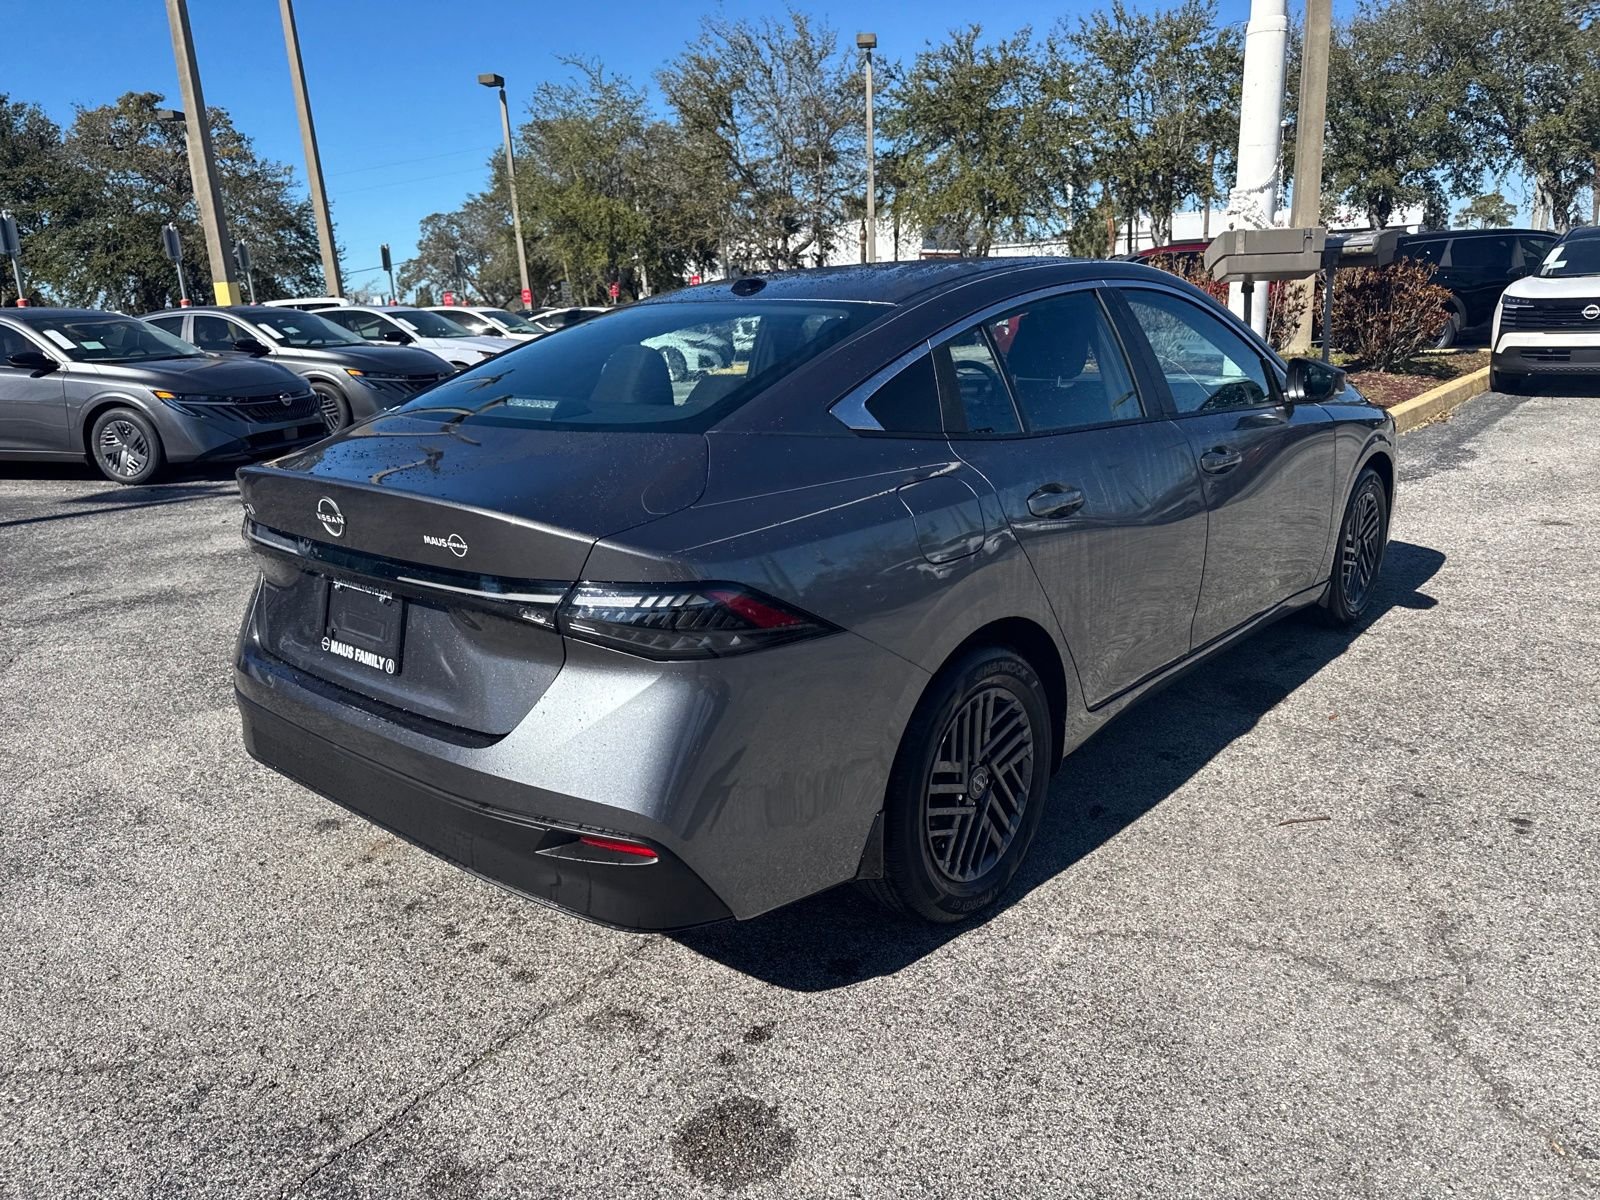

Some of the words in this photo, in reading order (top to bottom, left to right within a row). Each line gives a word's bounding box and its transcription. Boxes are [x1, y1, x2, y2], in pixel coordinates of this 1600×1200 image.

[316, 511, 345, 525] NISSAN
[423, 534, 448, 548] MAUS
[330, 640, 354, 659] MAUS
[354, 648, 386, 670] FAMILY
